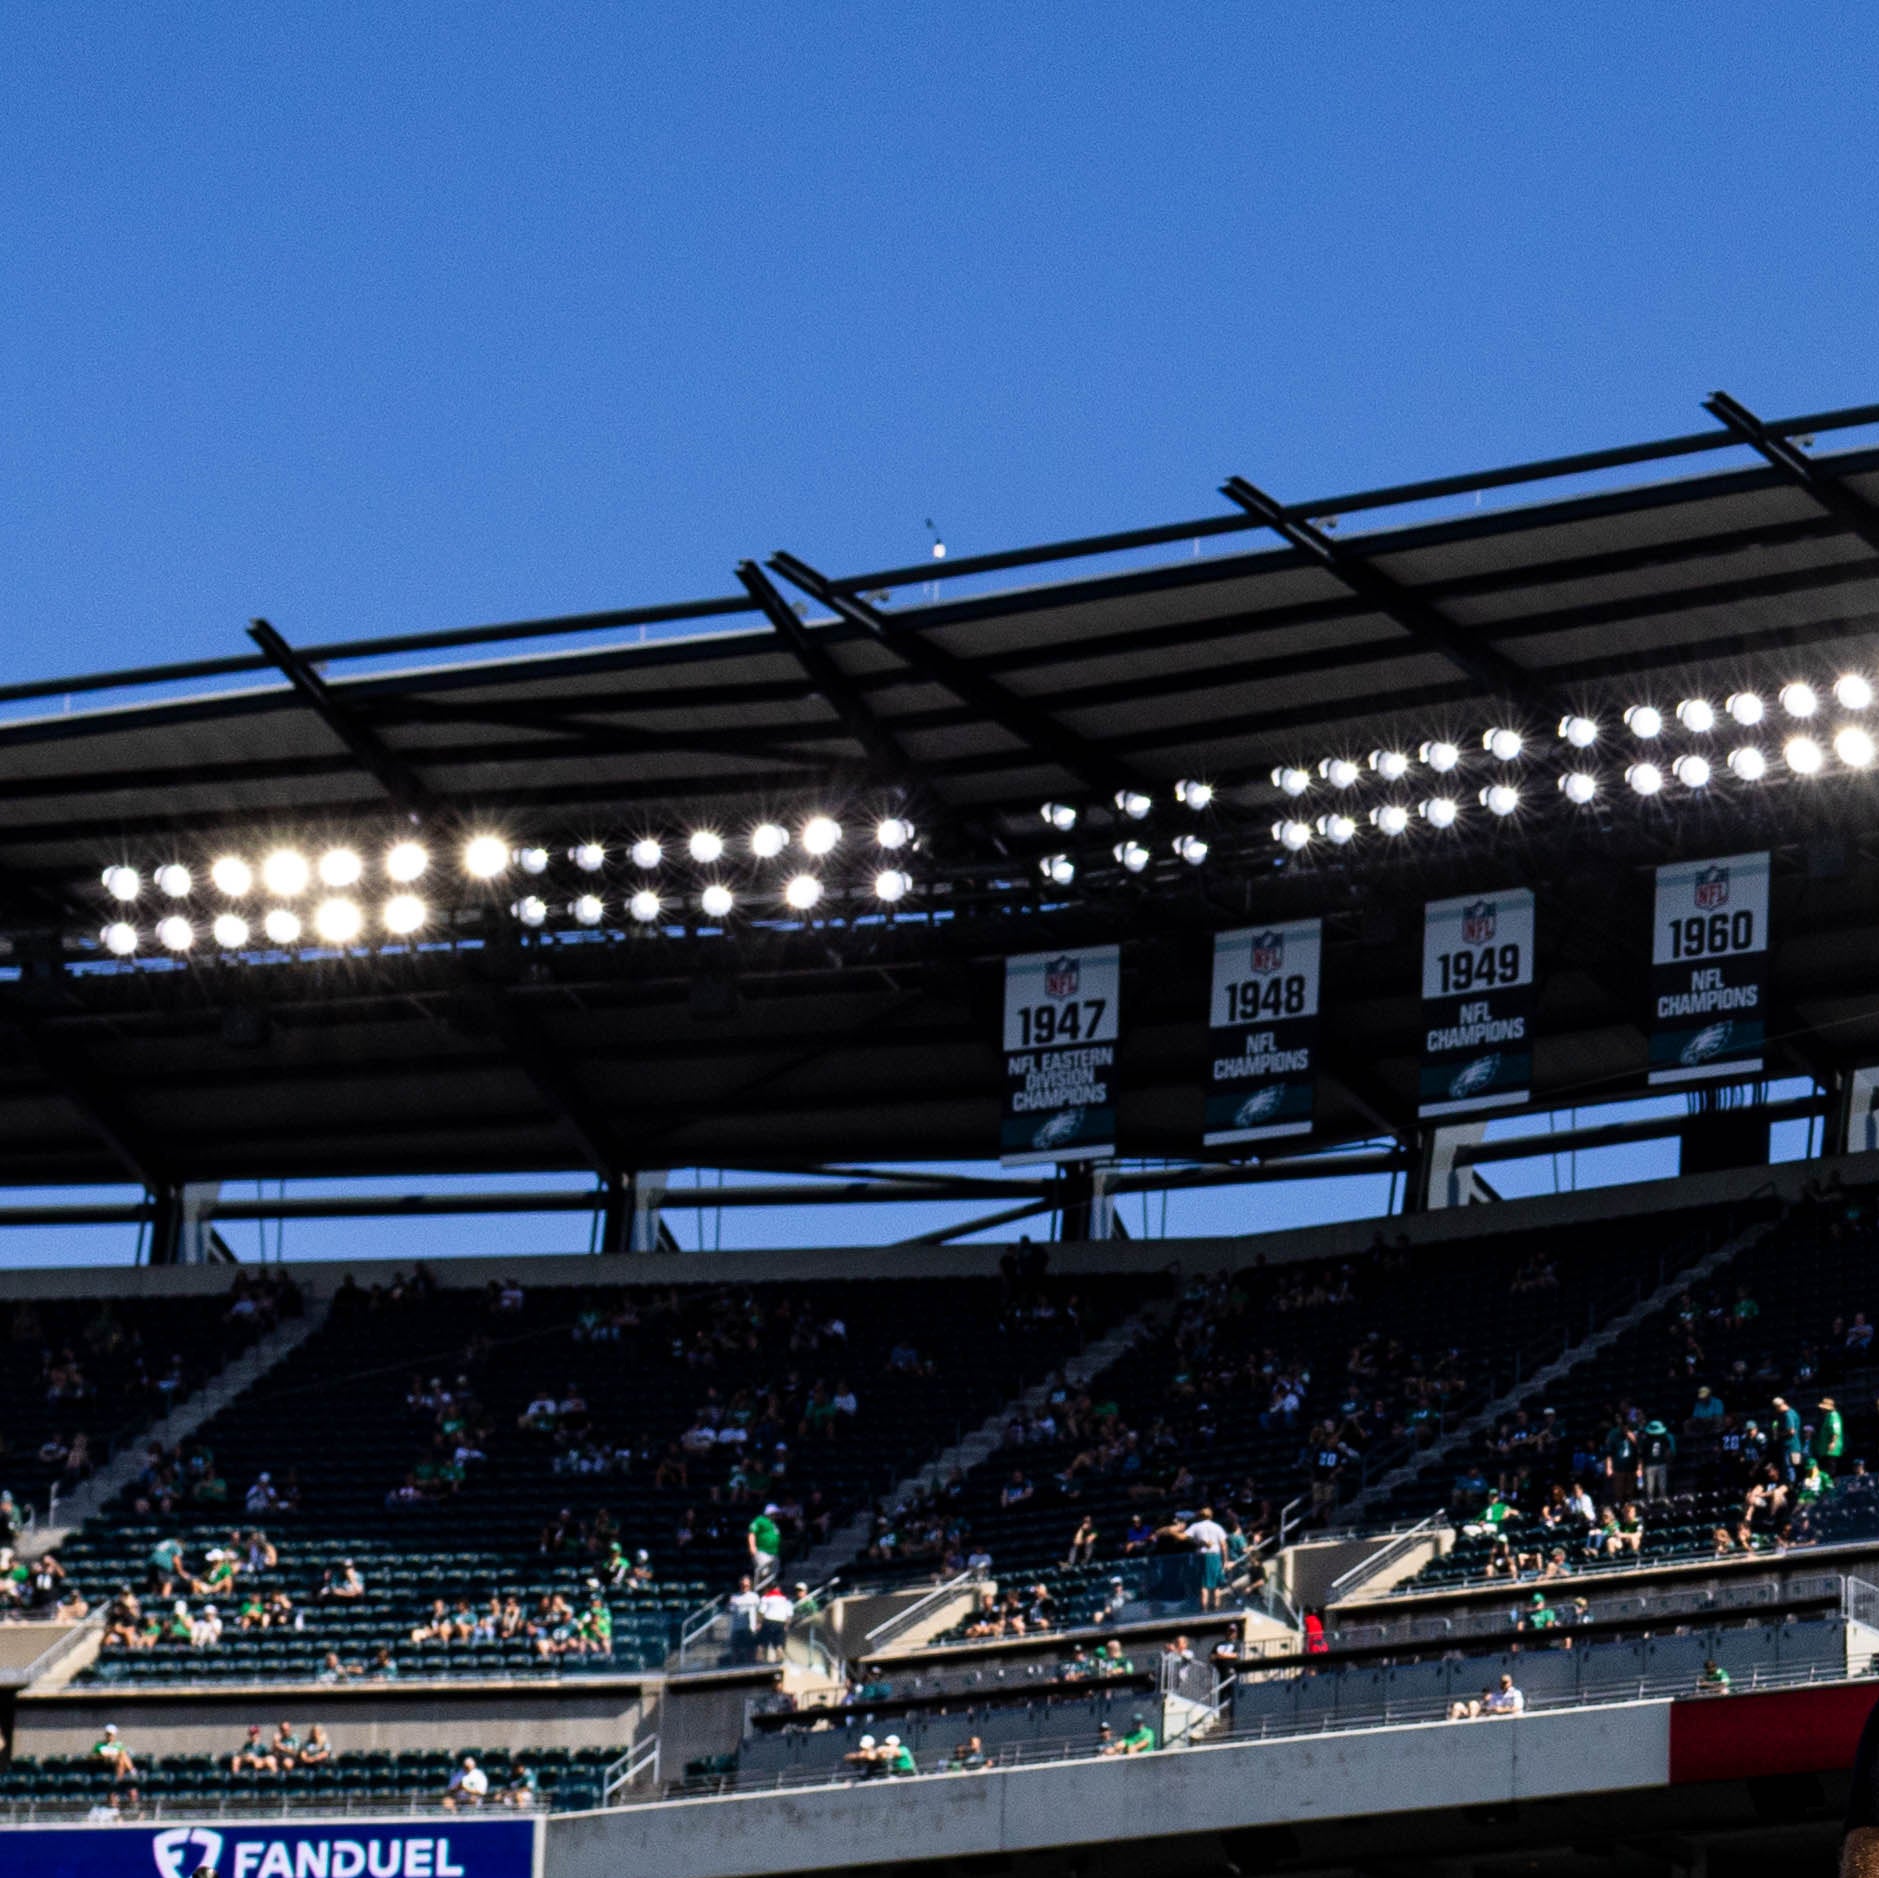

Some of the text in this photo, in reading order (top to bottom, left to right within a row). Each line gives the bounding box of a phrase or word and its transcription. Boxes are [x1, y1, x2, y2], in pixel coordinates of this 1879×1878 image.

[1669, 909, 1754, 960] 1960
[1438, 943, 1520, 993] 1949
[1691, 968, 1725, 993] NFL
[1225, 975, 1305, 1022] 1948
[1460, 1001, 1493, 1023] NFL
[1657, 985, 1759, 1020] CHAMPIONS
[1018, 1000, 1105, 1046] 1947
[1426, 1017, 1526, 1054] CHAMPIONS
[1246, 1031, 1279, 1056] NFL
[1008, 1045, 1115, 1076] NFL EASTERN
[1214, 1048, 1310, 1081] CHAMPIONS
[1025, 1066, 1095, 1090] DIVISION
[1013, 1082, 1107, 1112] CHAMPIONS
